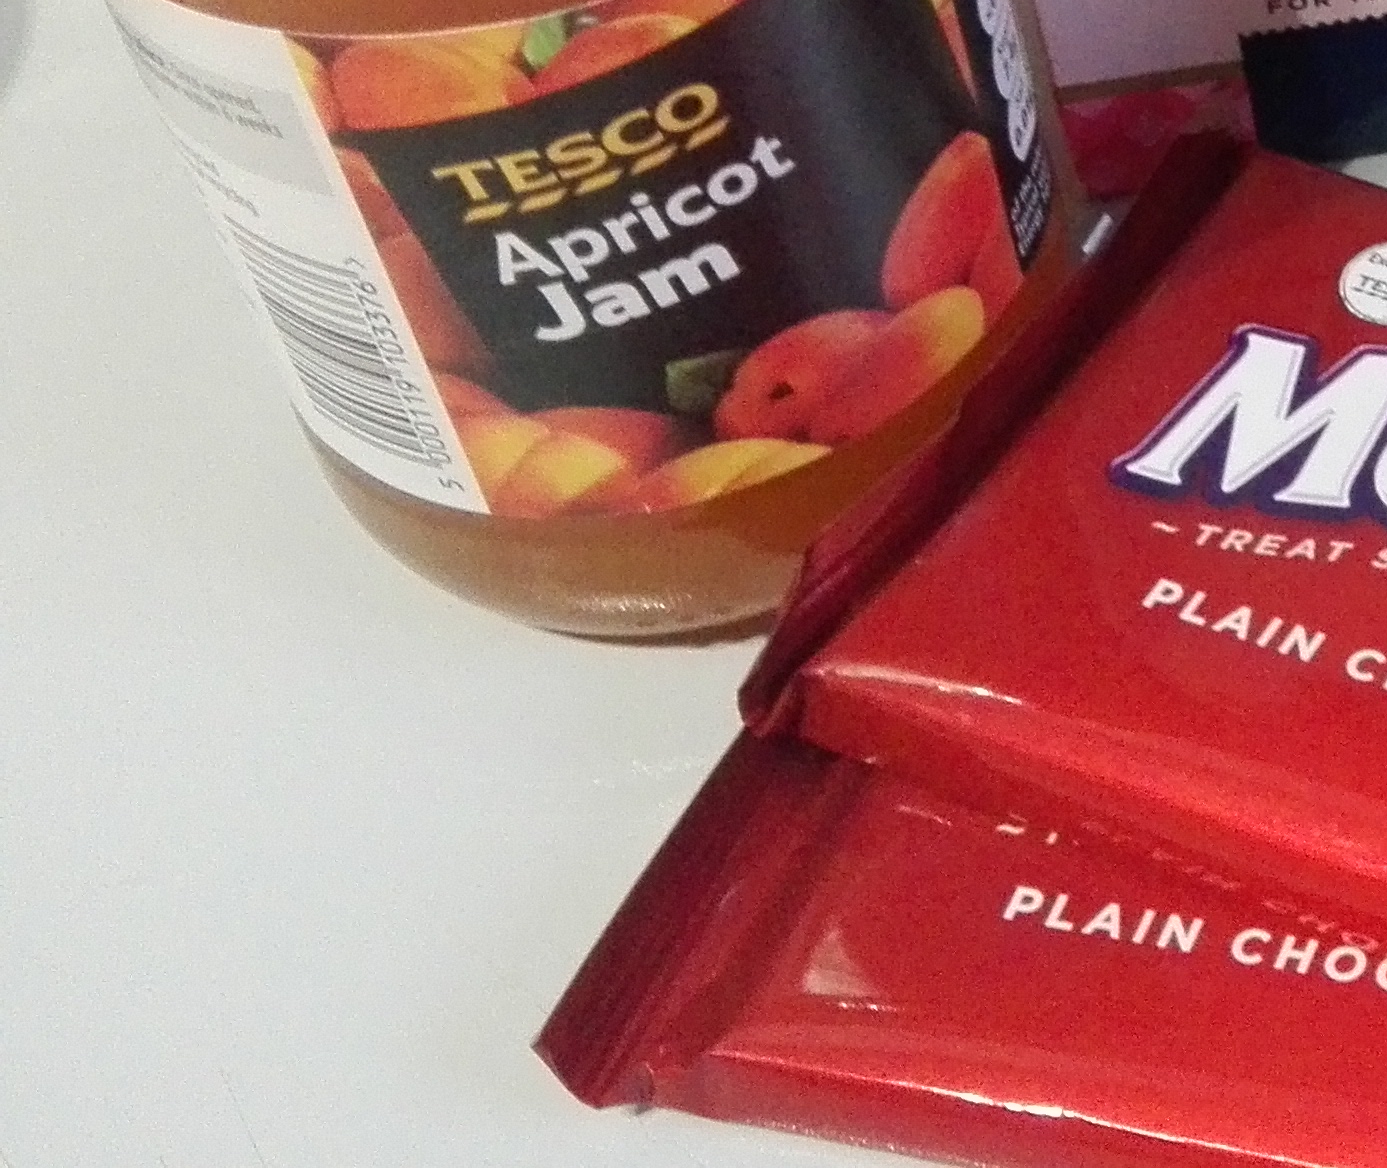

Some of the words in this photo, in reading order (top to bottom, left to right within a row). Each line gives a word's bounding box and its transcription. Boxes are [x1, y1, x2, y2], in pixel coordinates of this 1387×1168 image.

[432, 82, 720, 203] TESCO
[494, 134, 796, 286] Apricot
[535, 242, 741, 343] Jam
[1196, 524, 1356, 564] TREAT
[1141, 576, 1329, 664] PLAIN
[1000, 885, 1206, 954] PLAIN
